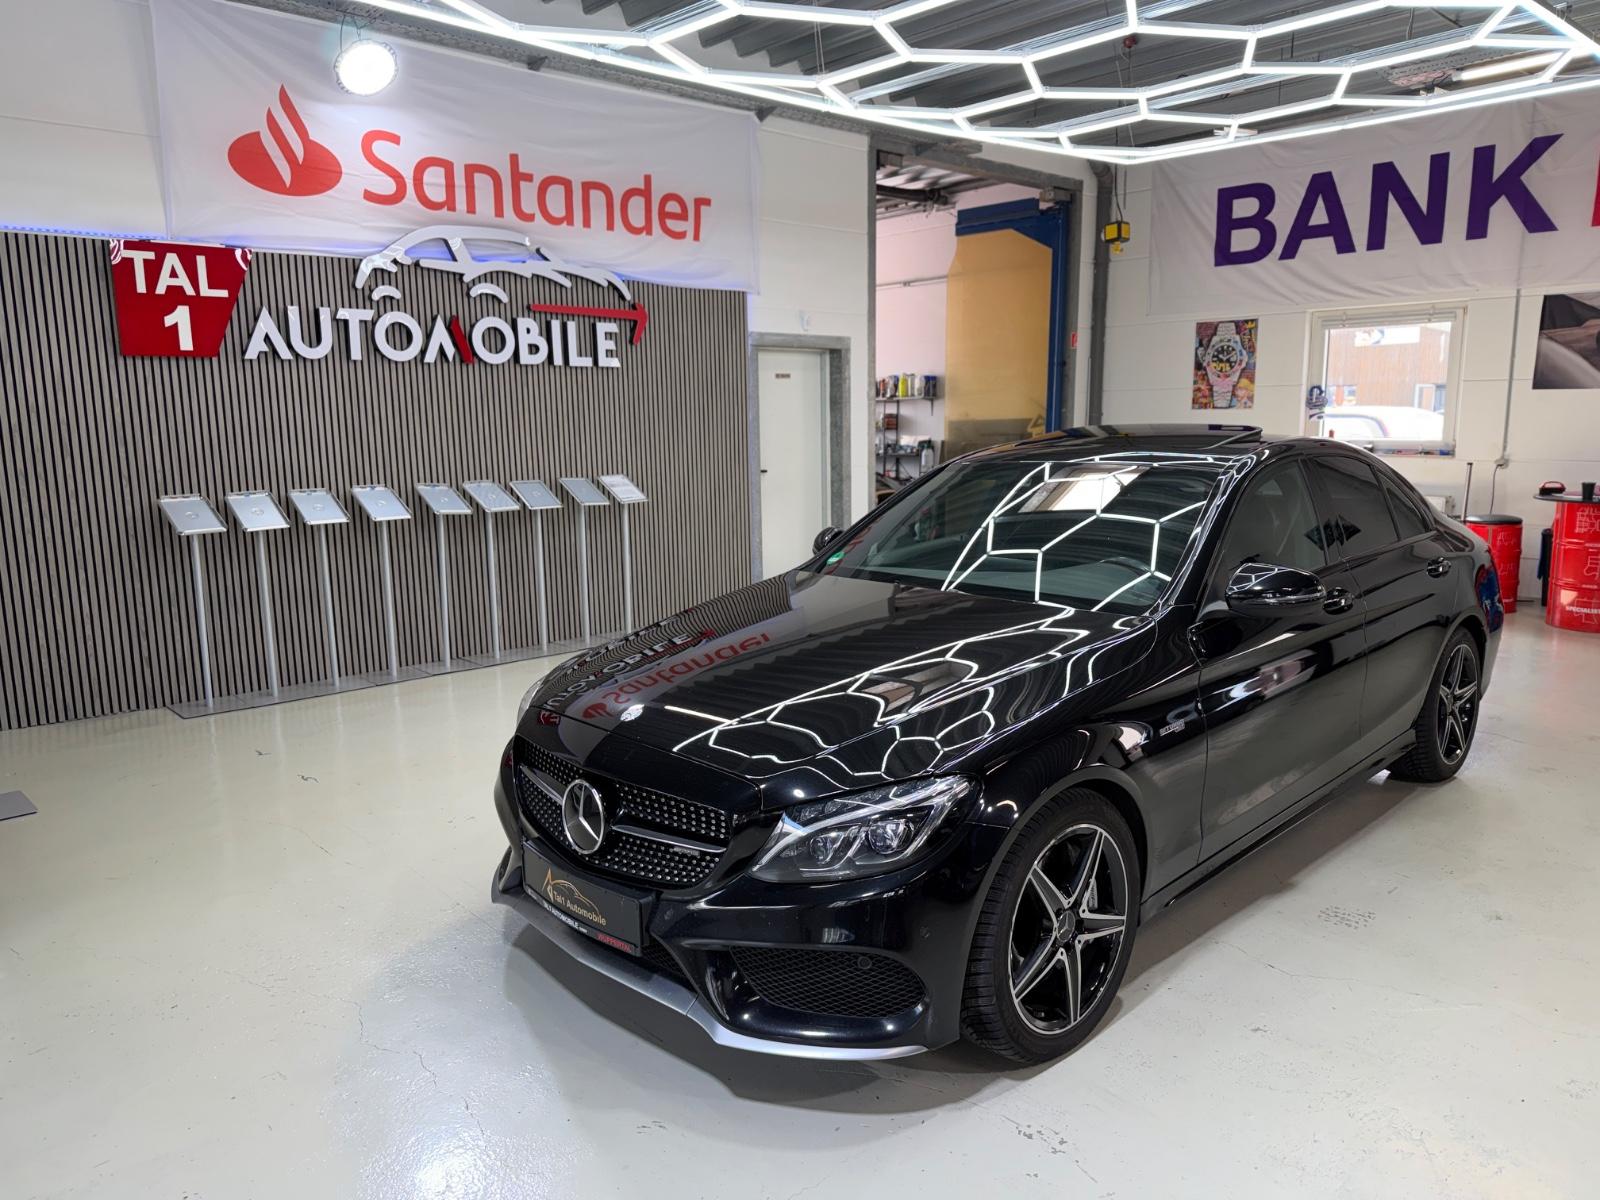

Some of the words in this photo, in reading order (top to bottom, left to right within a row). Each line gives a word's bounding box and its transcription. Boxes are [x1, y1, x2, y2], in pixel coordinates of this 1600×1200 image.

[361, 129, 712, 242] Santander
[1214, 133, 1564, 267] BANK
[121, 249, 229, 298] TAL
[164, 305, 194, 351] 1
[244, 306, 621, 368] AUTOMOBILE
[566, 899, 607, 926] Automobile
